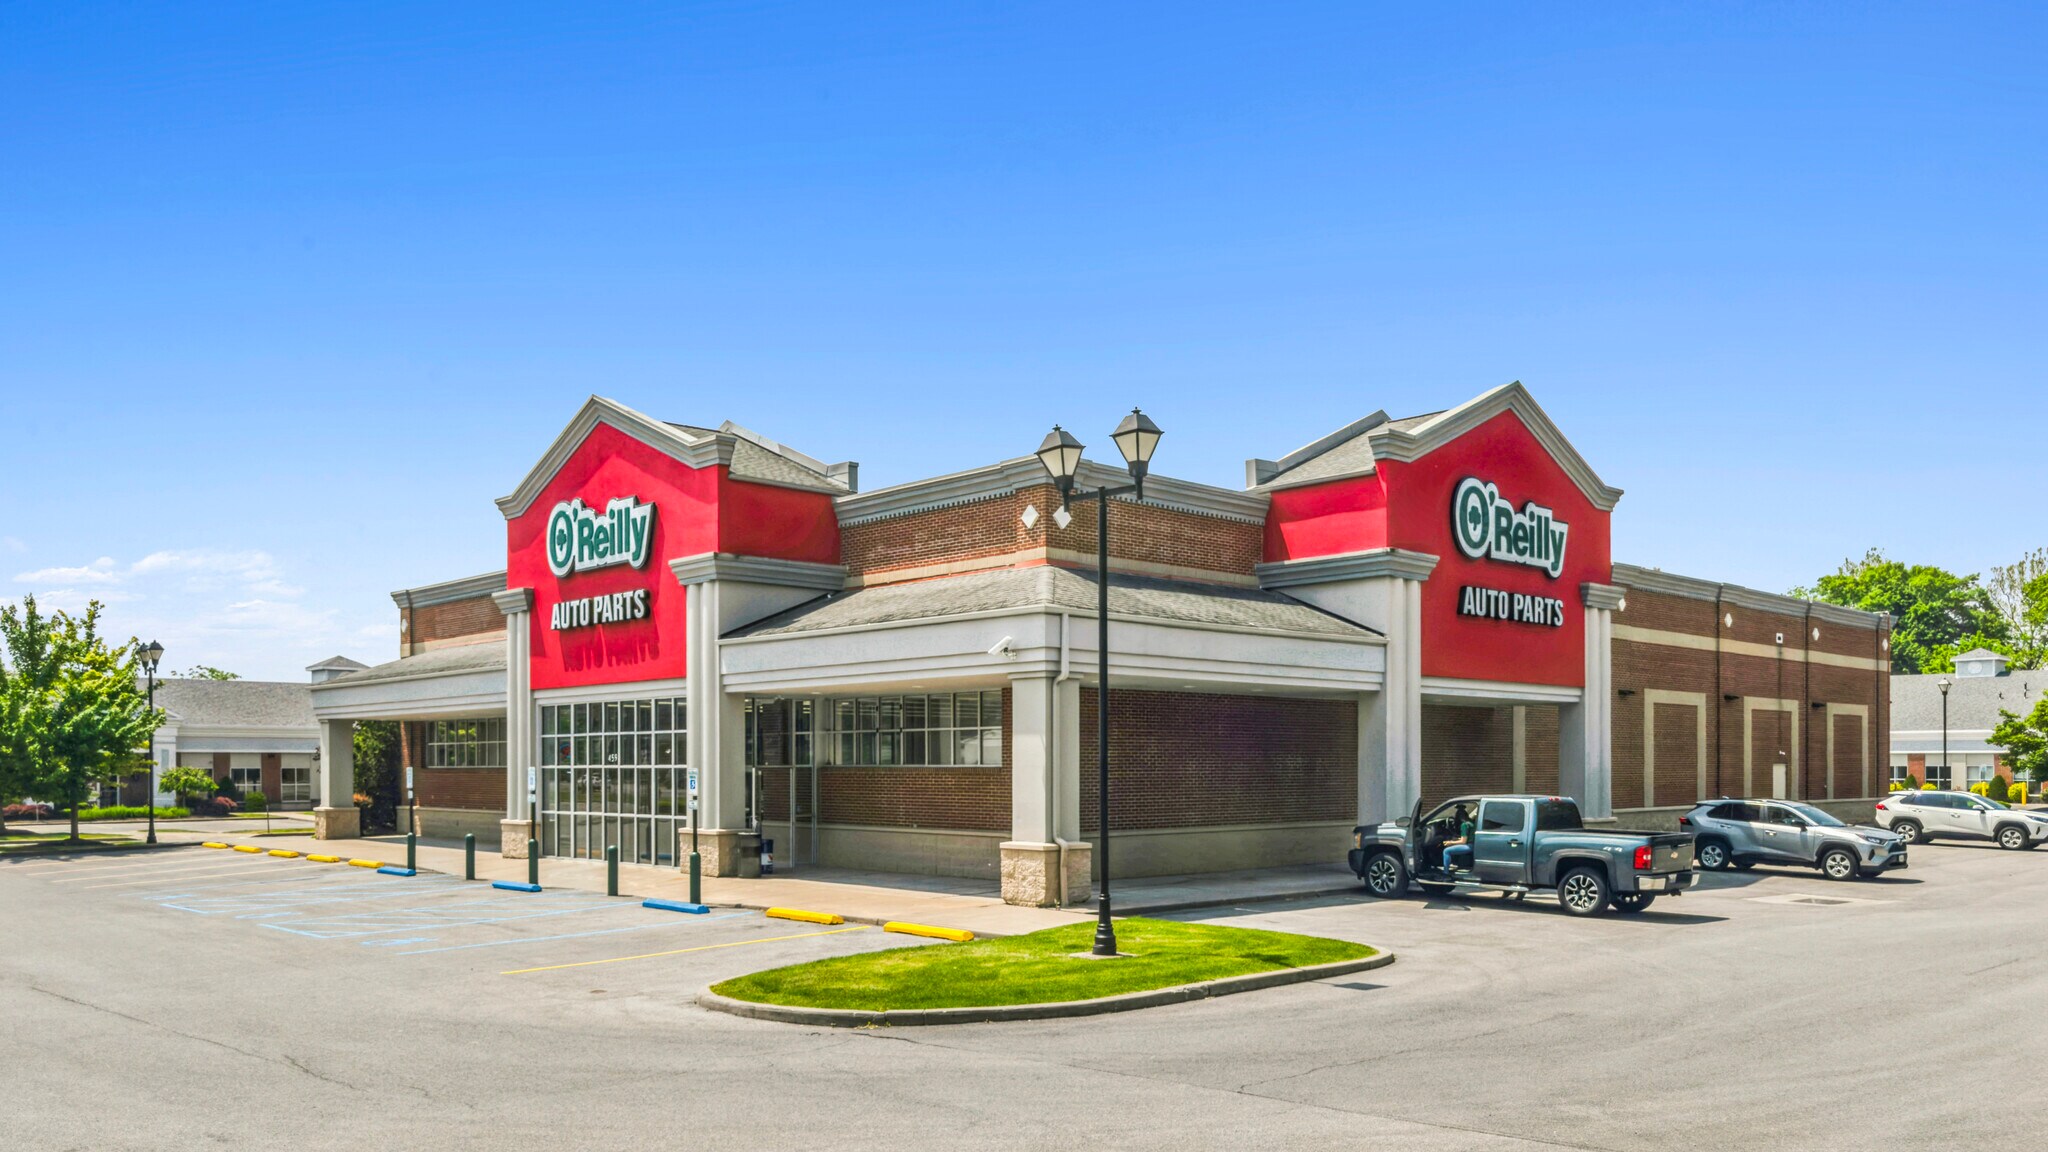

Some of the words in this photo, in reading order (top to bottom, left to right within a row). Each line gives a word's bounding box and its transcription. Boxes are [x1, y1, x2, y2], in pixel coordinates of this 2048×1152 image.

[549, 506, 647, 569] O'Reilly
[1459, 485, 1565, 571] O'Reilly
[551, 598, 589, 630] AUTO
[593, 589, 646, 624] PARTS
[1463, 586, 1508, 619] AUTO
[1513, 593, 1564, 627] PARTS
